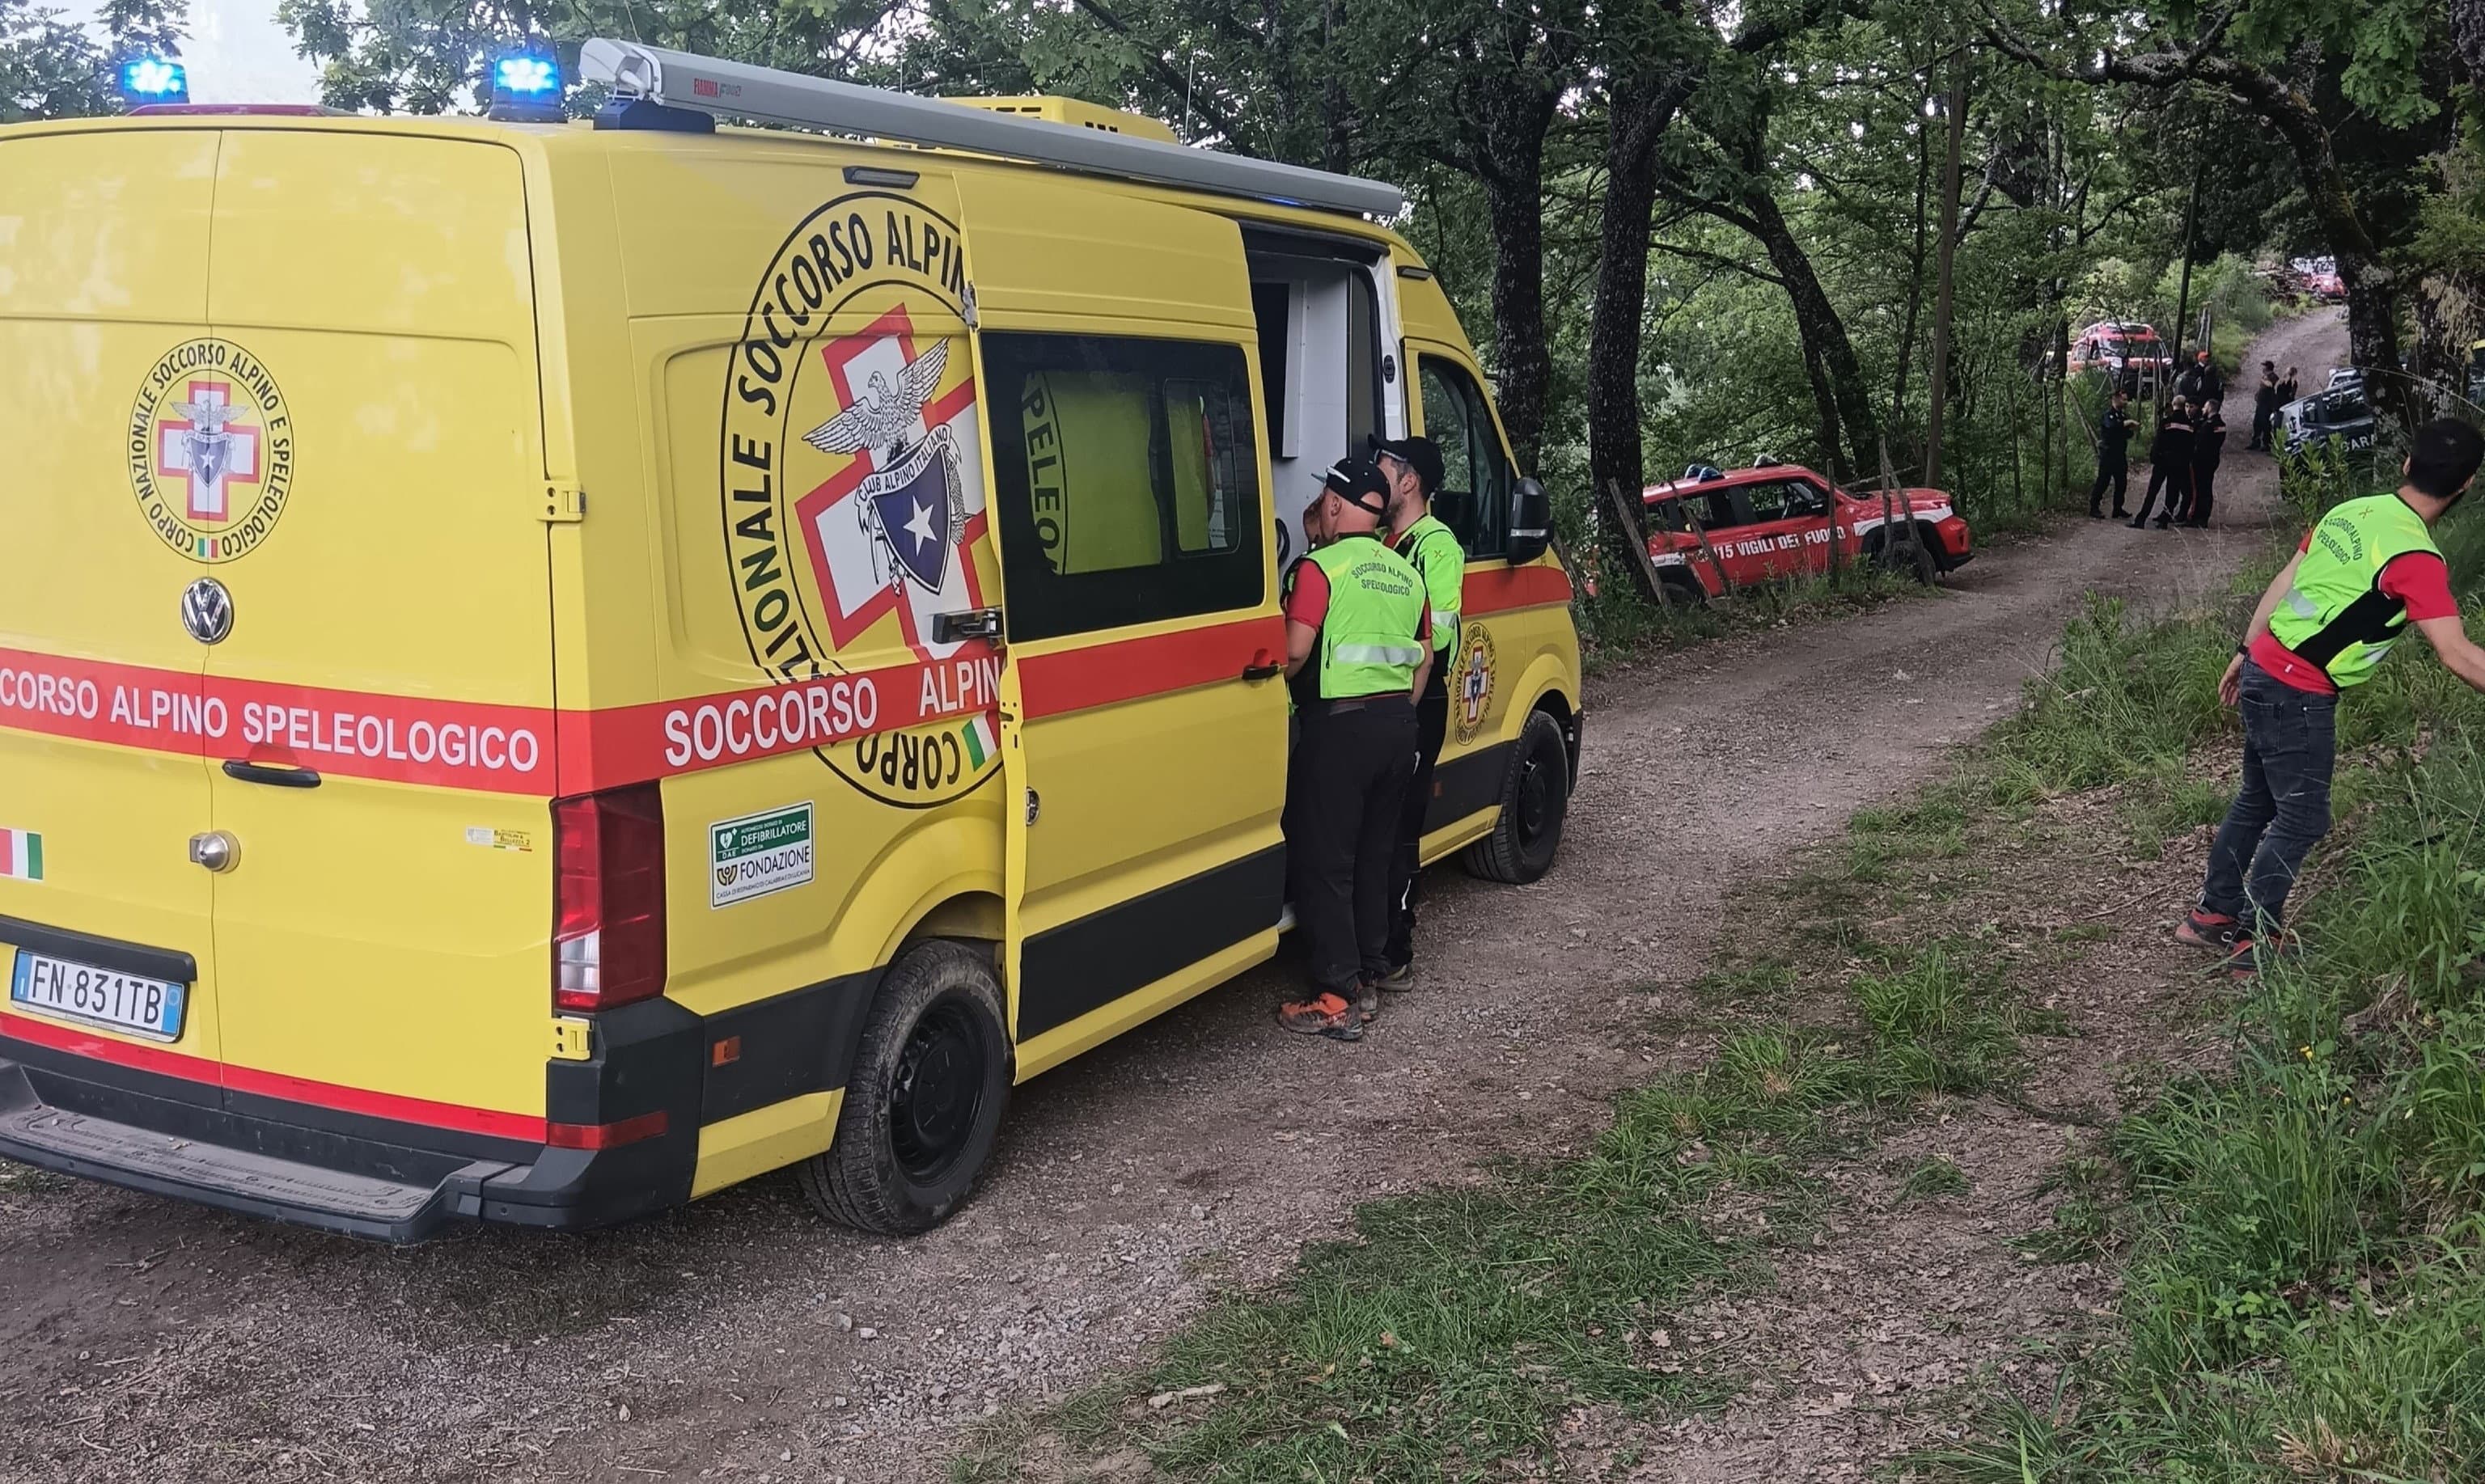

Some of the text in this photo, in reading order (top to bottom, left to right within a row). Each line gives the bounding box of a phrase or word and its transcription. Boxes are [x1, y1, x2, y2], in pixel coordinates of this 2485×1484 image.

[738, 213, 873, 417] SOCCORSO
[152, 344, 226, 390] SOCCORSO
[229, 352, 279, 412] ALPINO
[131, 386, 158, 501] NAZIONALE
[269, 416, 286, 431] E
[858, 427, 948, 502] CLUB ALPINO ITALIANO
[1022, 387, 1060, 571] PELEO
[222, 438, 290, 556] SPELEOLOGICO
[149, 502, 195, 553] CORPO
[1736, 537, 1776, 556] VIGILI
[1804, 525, 1846, 546] FUOO
[732, 433, 835, 683] ZIONALE
[1351, 562, 1414, 589] SOCCORSO ALPINO
[1361, 578, 1411, 597] SPELEOLOGICO
[110, 684, 229, 739] ALPINO
[243, 701, 539, 772] SPELEOLOGICO
[665, 655, 1000, 767] SOCCORSO ALPIN
[856, 731, 961, 790] CORPO
[722, 850, 737, 860] DAE
[741, 820, 806, 846] DEFIBRILLATORE
[740, 846, 810, 881] FONDAZIONE
